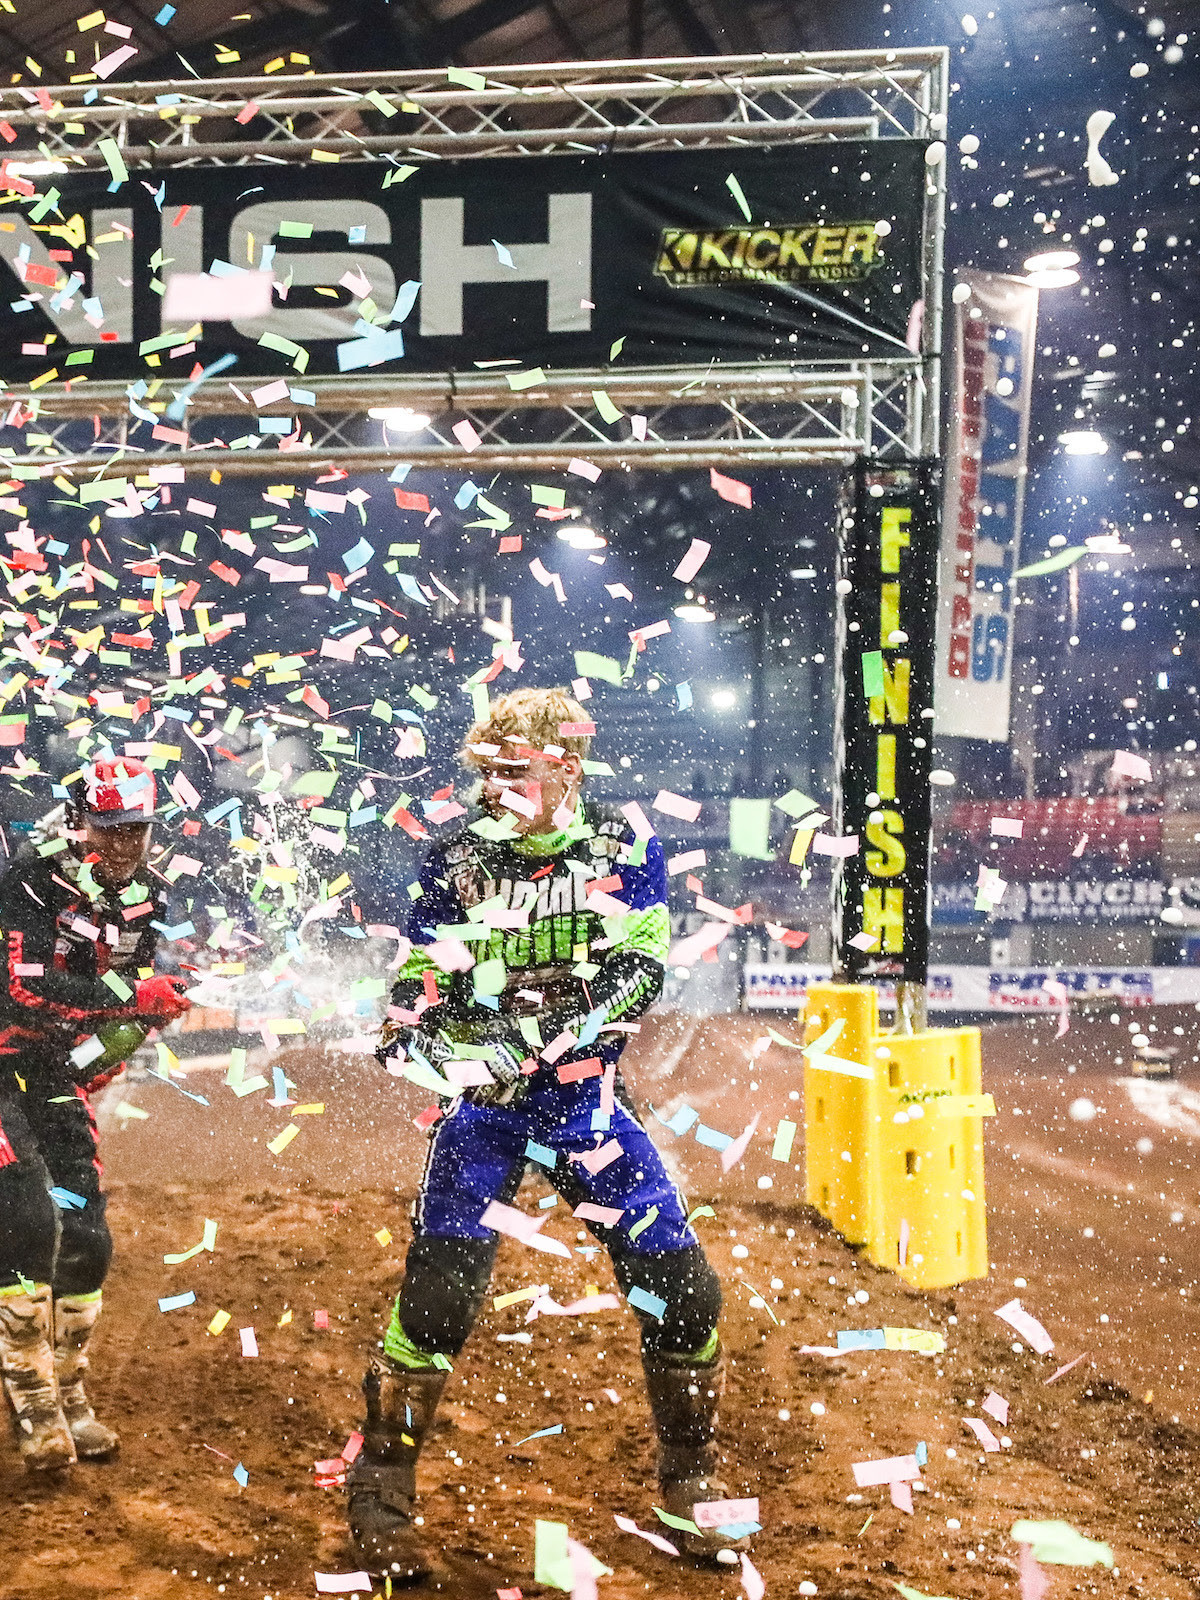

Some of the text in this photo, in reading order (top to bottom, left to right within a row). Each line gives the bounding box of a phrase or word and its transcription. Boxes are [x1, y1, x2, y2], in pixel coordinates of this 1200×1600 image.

[700, 226, 878, 268] KICKER
[809, 265, 861, 279] AUDIO
[862, 507, 912, 953] FINISH
[1029, 880, 1164, 903] CINCH
